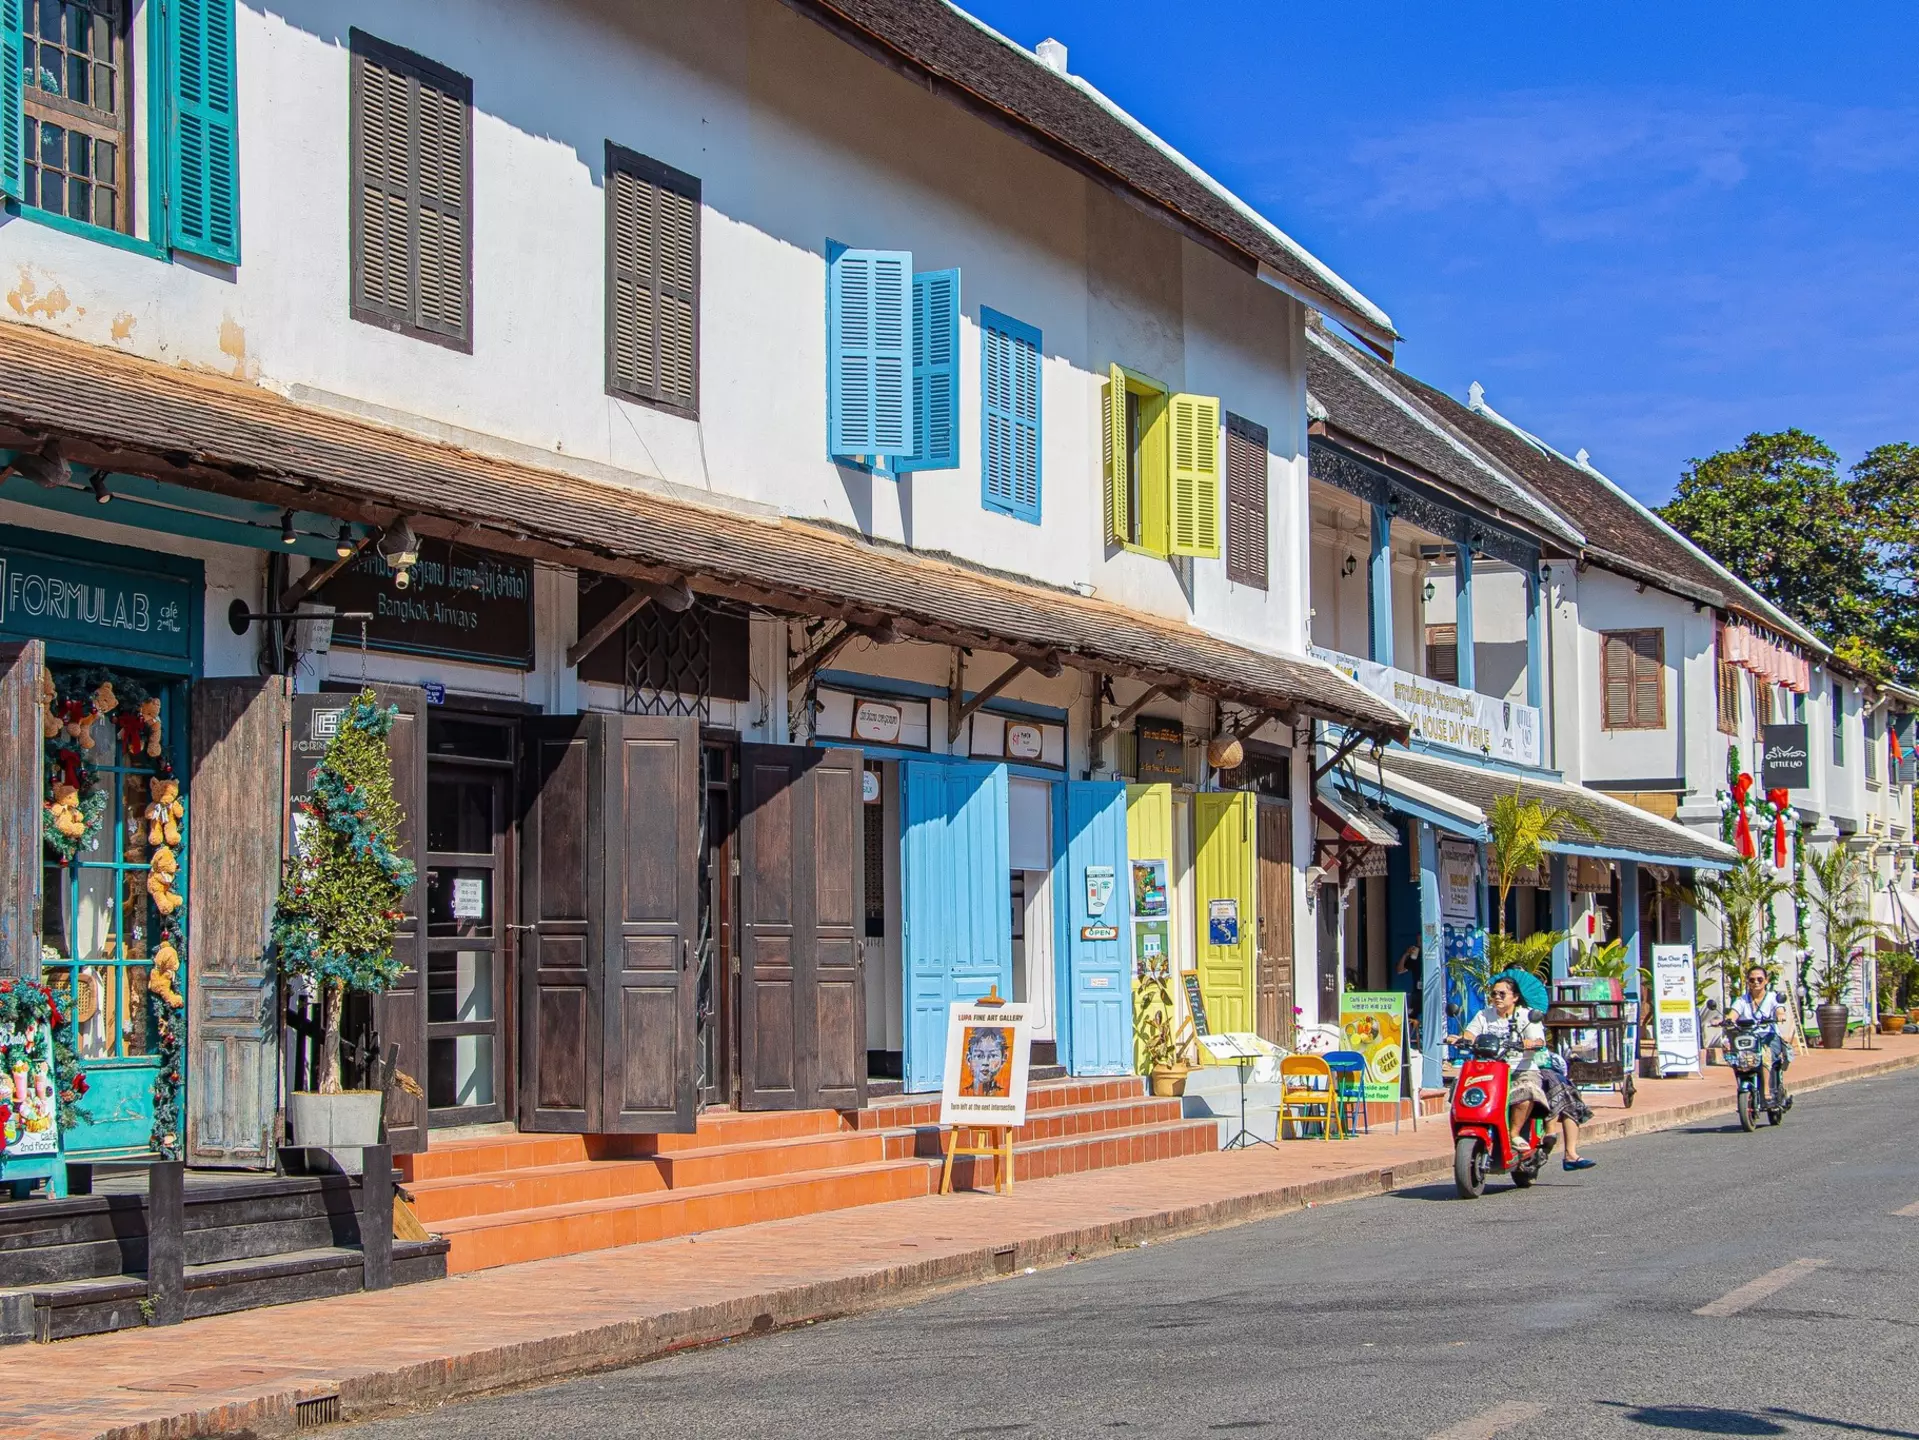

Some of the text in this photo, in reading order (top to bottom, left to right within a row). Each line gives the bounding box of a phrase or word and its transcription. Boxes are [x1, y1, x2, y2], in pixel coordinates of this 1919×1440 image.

[378, 592, 477, 631] Bangkok Airways
[1422, 715, 1447, 741] HOUSE
[1449, 720, 1466, 746] DAY
[1770, 761, 1803, 769] LITTLE LAO
[999, 1014, 1023, 1022] GALLERY
[991, 1104, 1016, 1112] intersection
[20, 1141, 52, 1152] 2nd floor
